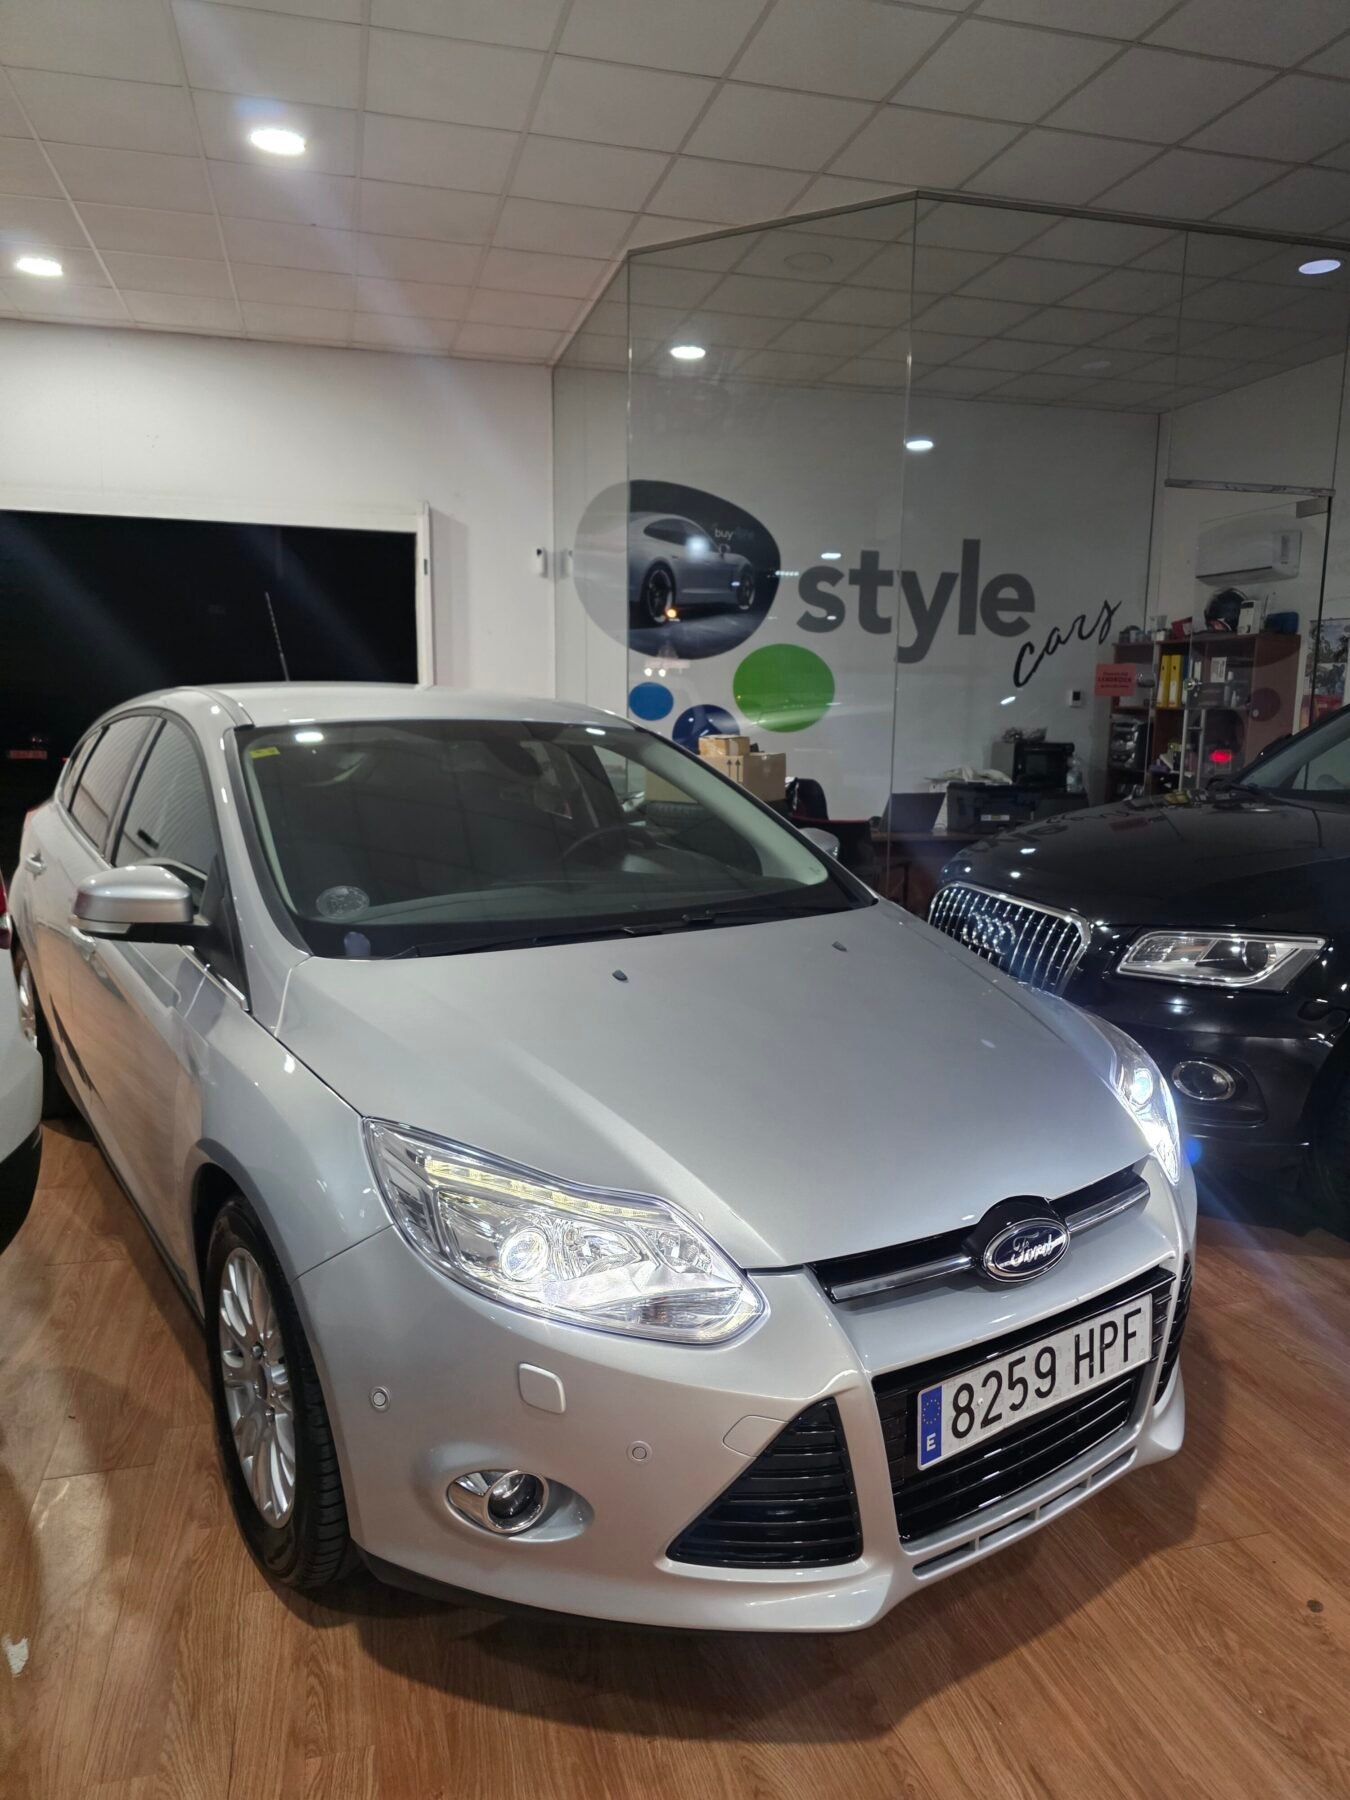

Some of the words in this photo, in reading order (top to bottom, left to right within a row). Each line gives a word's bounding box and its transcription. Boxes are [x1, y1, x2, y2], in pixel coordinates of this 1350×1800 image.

[714, 528, 734, 541] buy
[796, 538, 1036, 663] style
[1012, 599, 1123, 688] cars
[1004, 1231, 1062, 1268] Ford
[951, 1345, 1057, 1440] 8259
[1074, 1307, 1142, 1386] HPF
[926, 1432, 936, 1451] E
